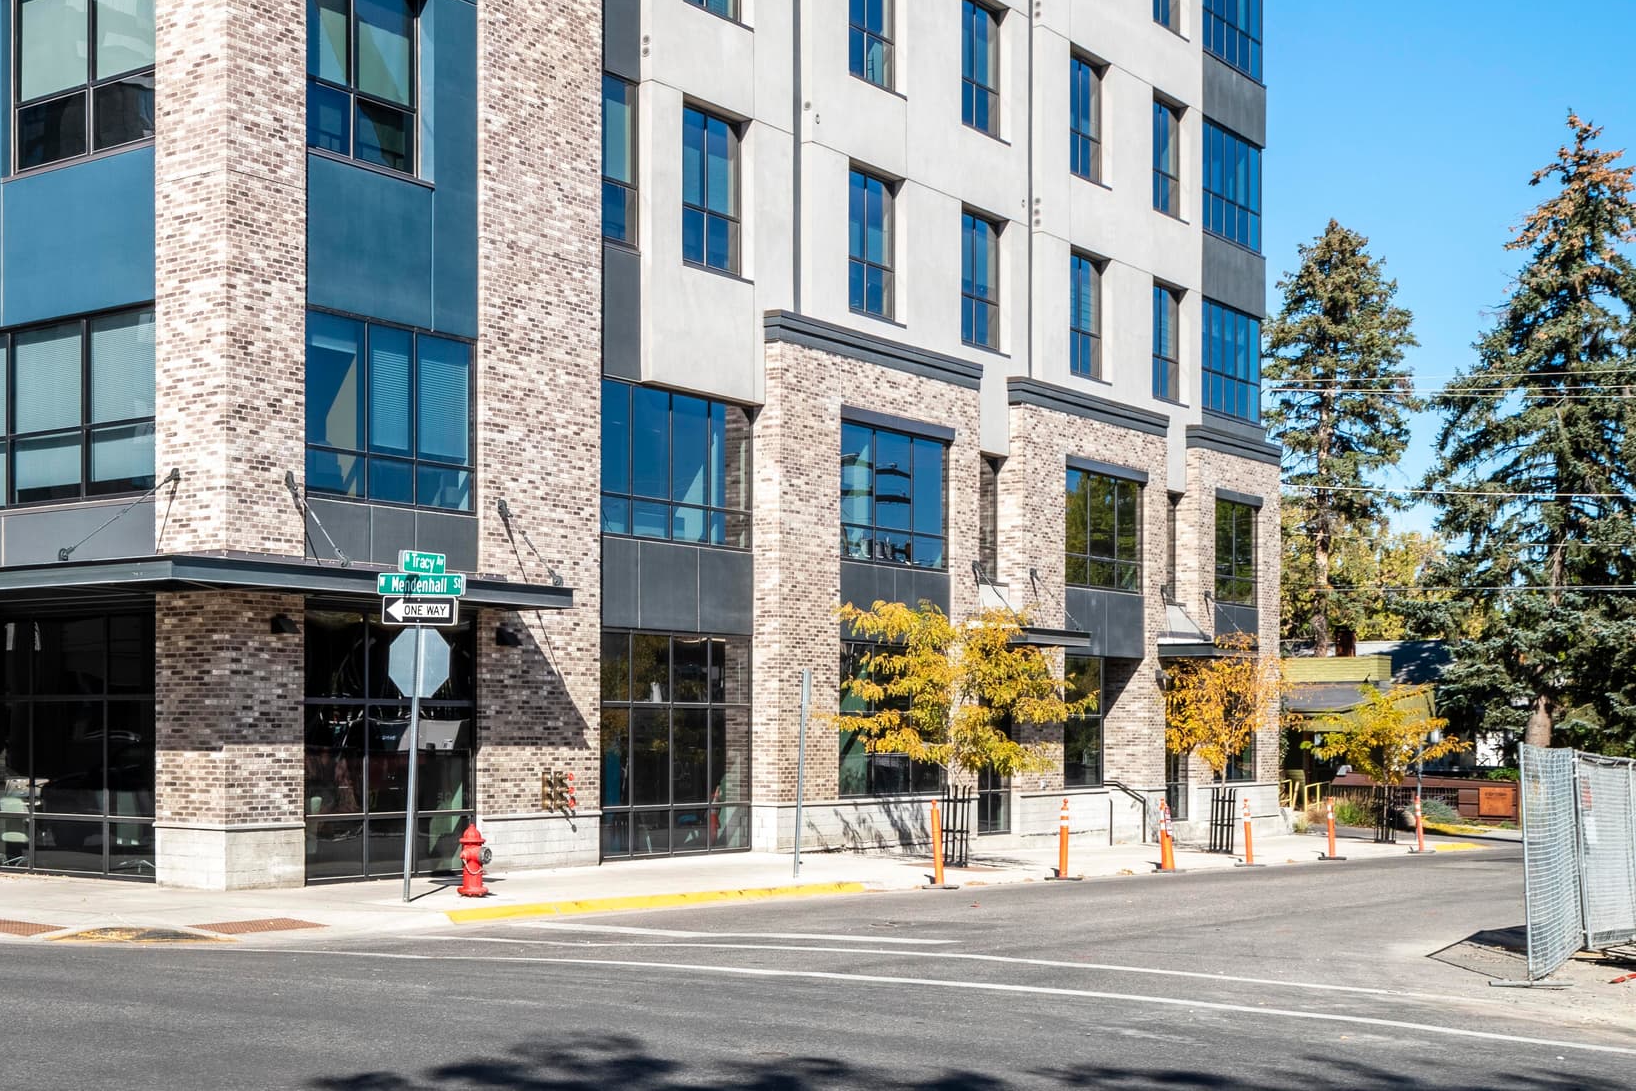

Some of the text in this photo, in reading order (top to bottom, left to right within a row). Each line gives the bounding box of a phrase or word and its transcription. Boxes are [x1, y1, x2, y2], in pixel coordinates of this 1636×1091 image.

[411, 553, 436, 573] Tracy
[379, 576, 461, 593] W Mendenhall St
[404, 605, 447, 616] ONE WAY
